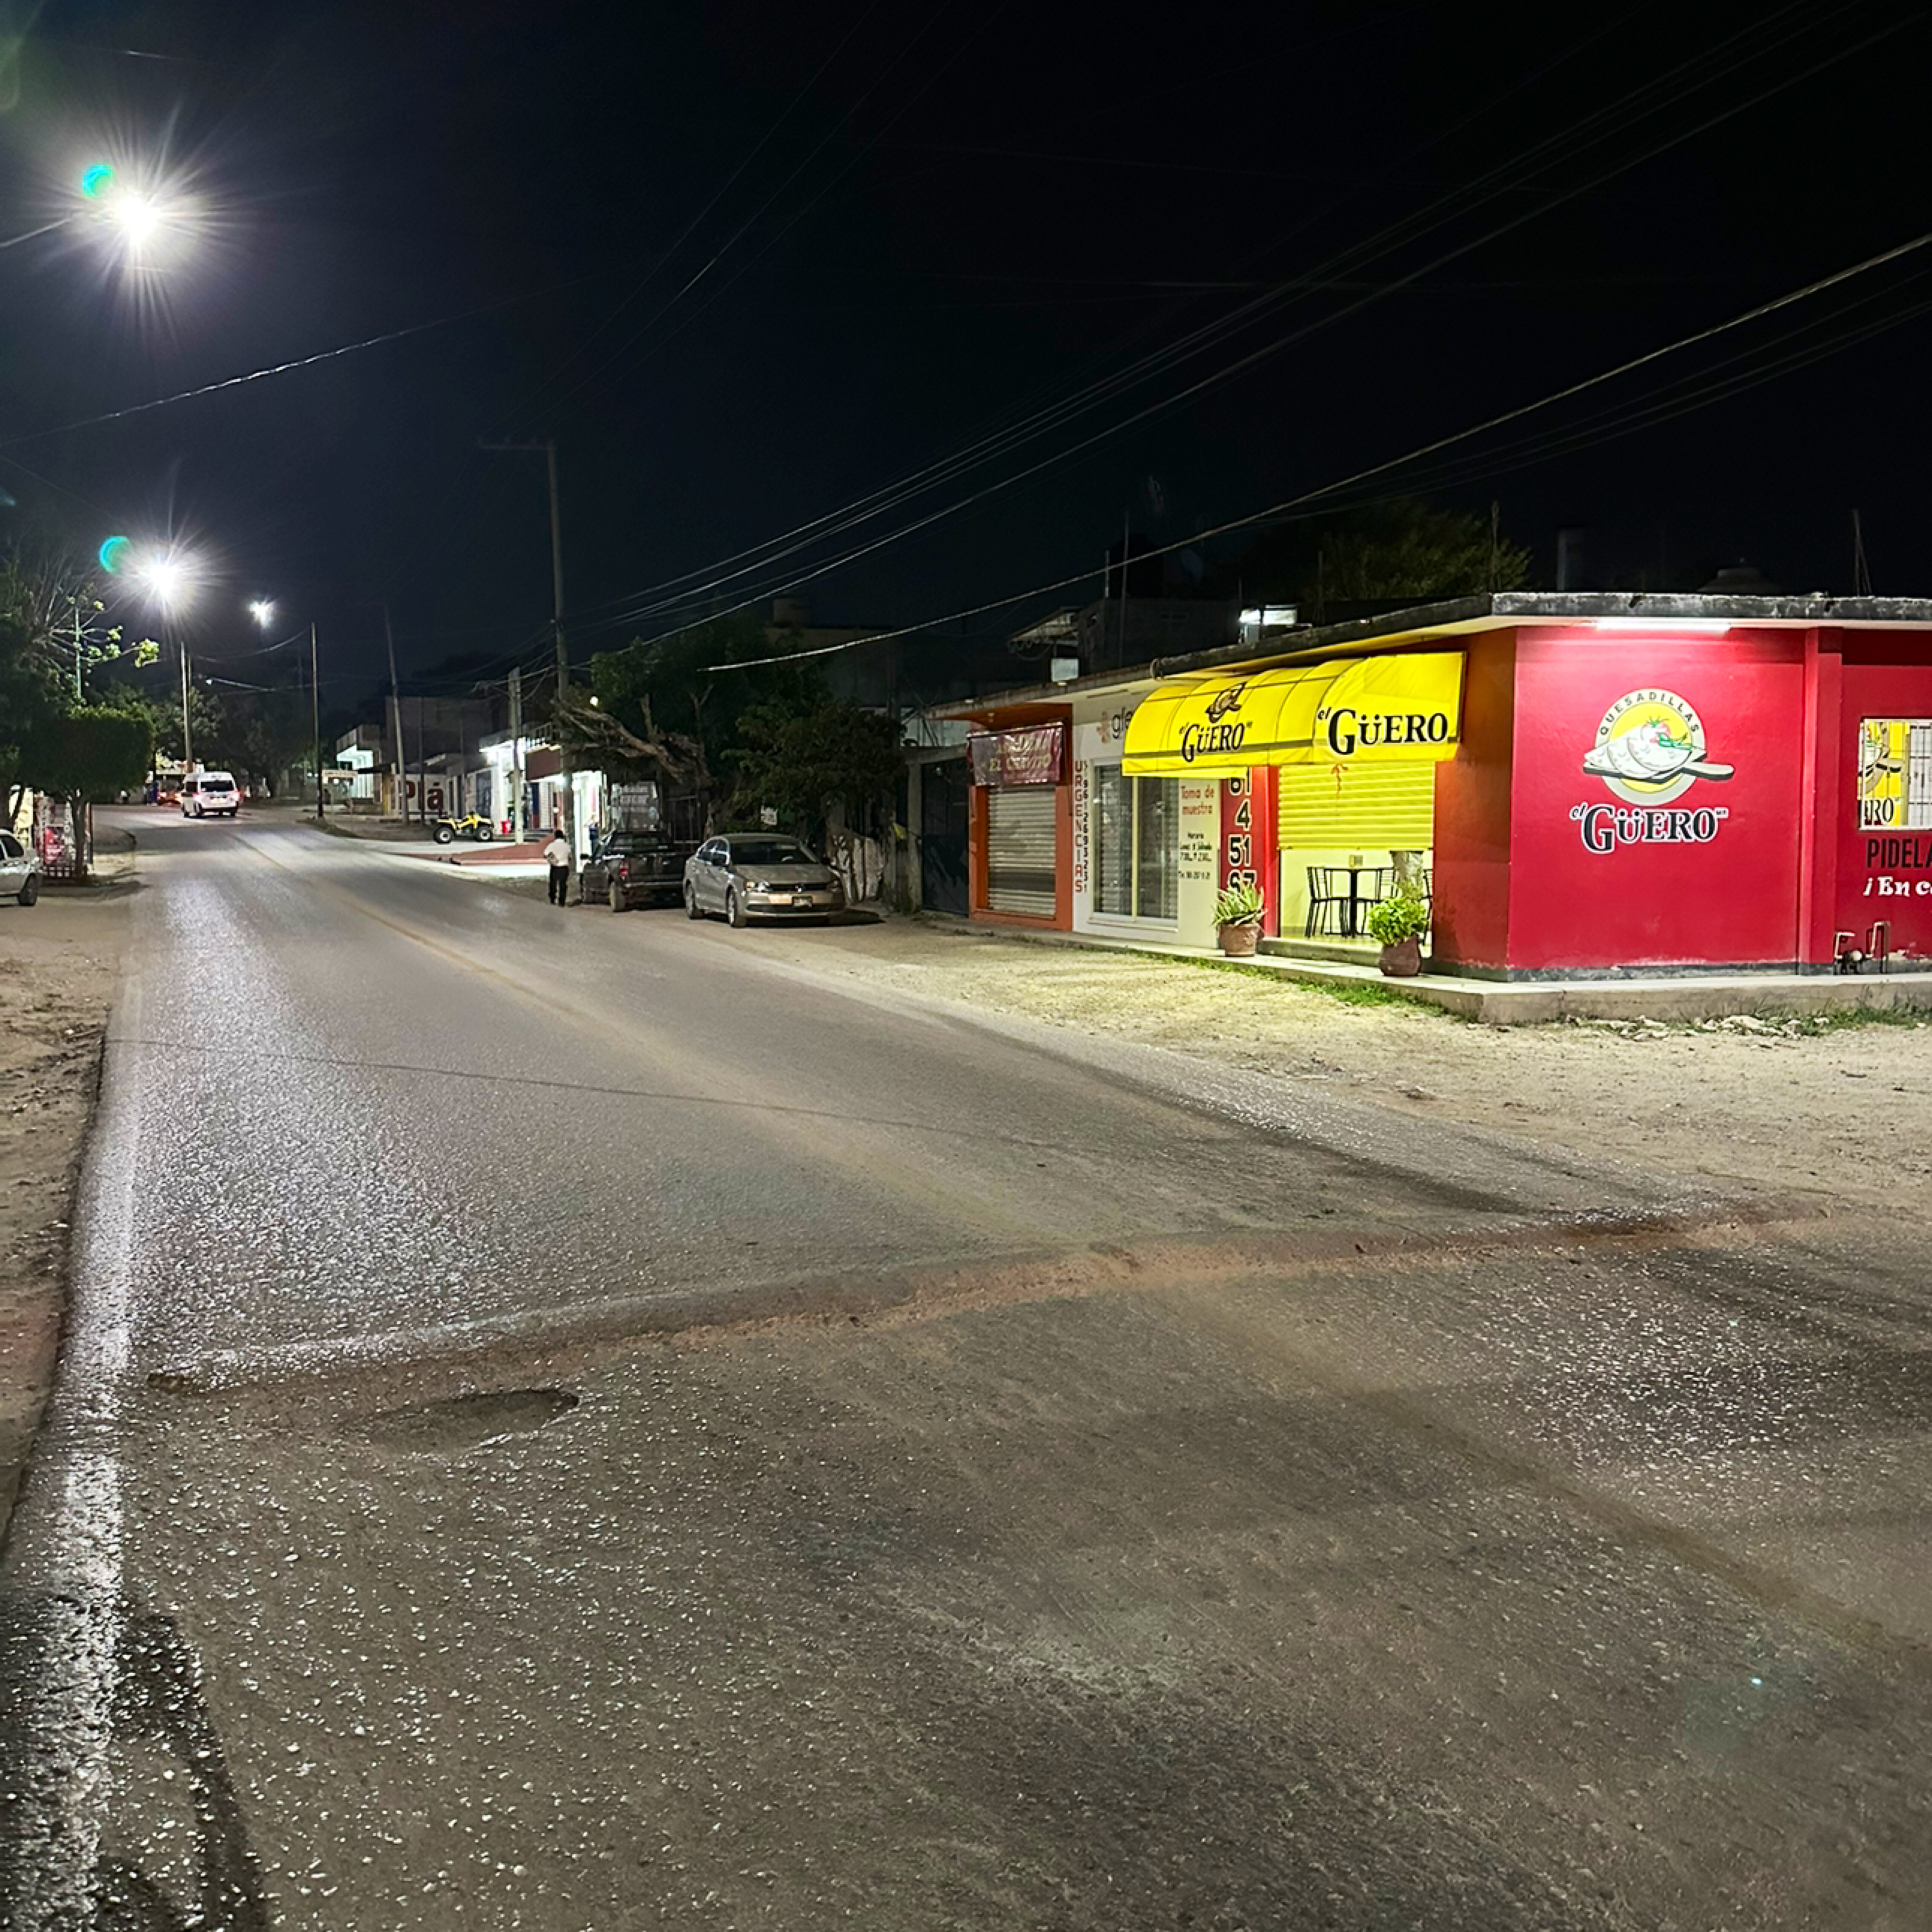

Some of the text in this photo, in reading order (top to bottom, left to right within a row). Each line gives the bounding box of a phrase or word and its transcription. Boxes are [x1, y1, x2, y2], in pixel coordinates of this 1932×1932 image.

[1318, 707, 1448, 755] el GÜERO
[1599, 691, 1699, 735] QUESADILLAS
[1183, 723, 1245, 763] GÜERO
[1205, 784, 1215, 799] de
[1235, 799, 1252, 831] 4
[1571, 803, 1586, 818] el
[1582, 804, 1717, 853] GÜERO
[1229, 836, 1251, 866] 51
